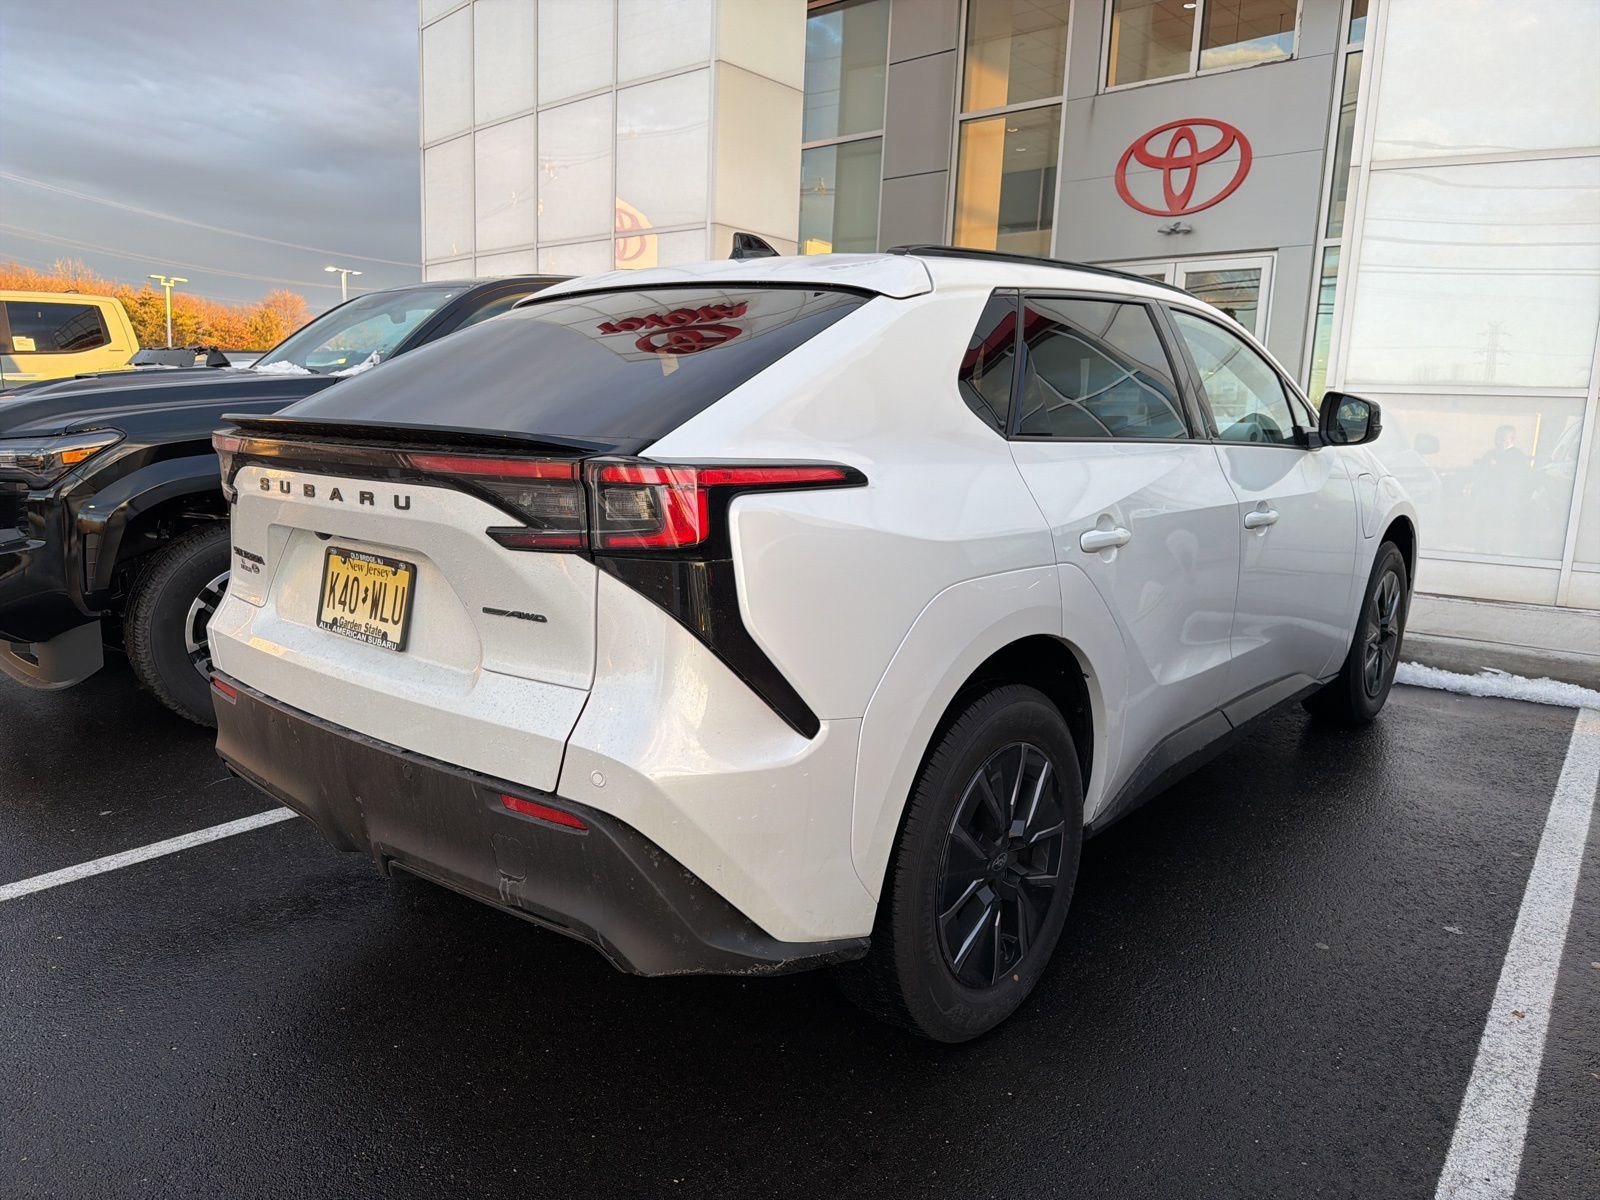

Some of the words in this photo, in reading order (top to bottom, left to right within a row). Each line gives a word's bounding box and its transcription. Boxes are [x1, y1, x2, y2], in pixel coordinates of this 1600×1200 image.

[260, 477, 411, 510] SUBARU
[347, 558, 365, 572] New
[365, 562, 391, 580] Jersey
[319, 622, 331, 631] ALL
[332, 626, 367, 641] AMERICAN
[367, 636, 397, 650] SUBARU
[338, 616, 362, 631] Garden
[363, 622, 382, 638] State
